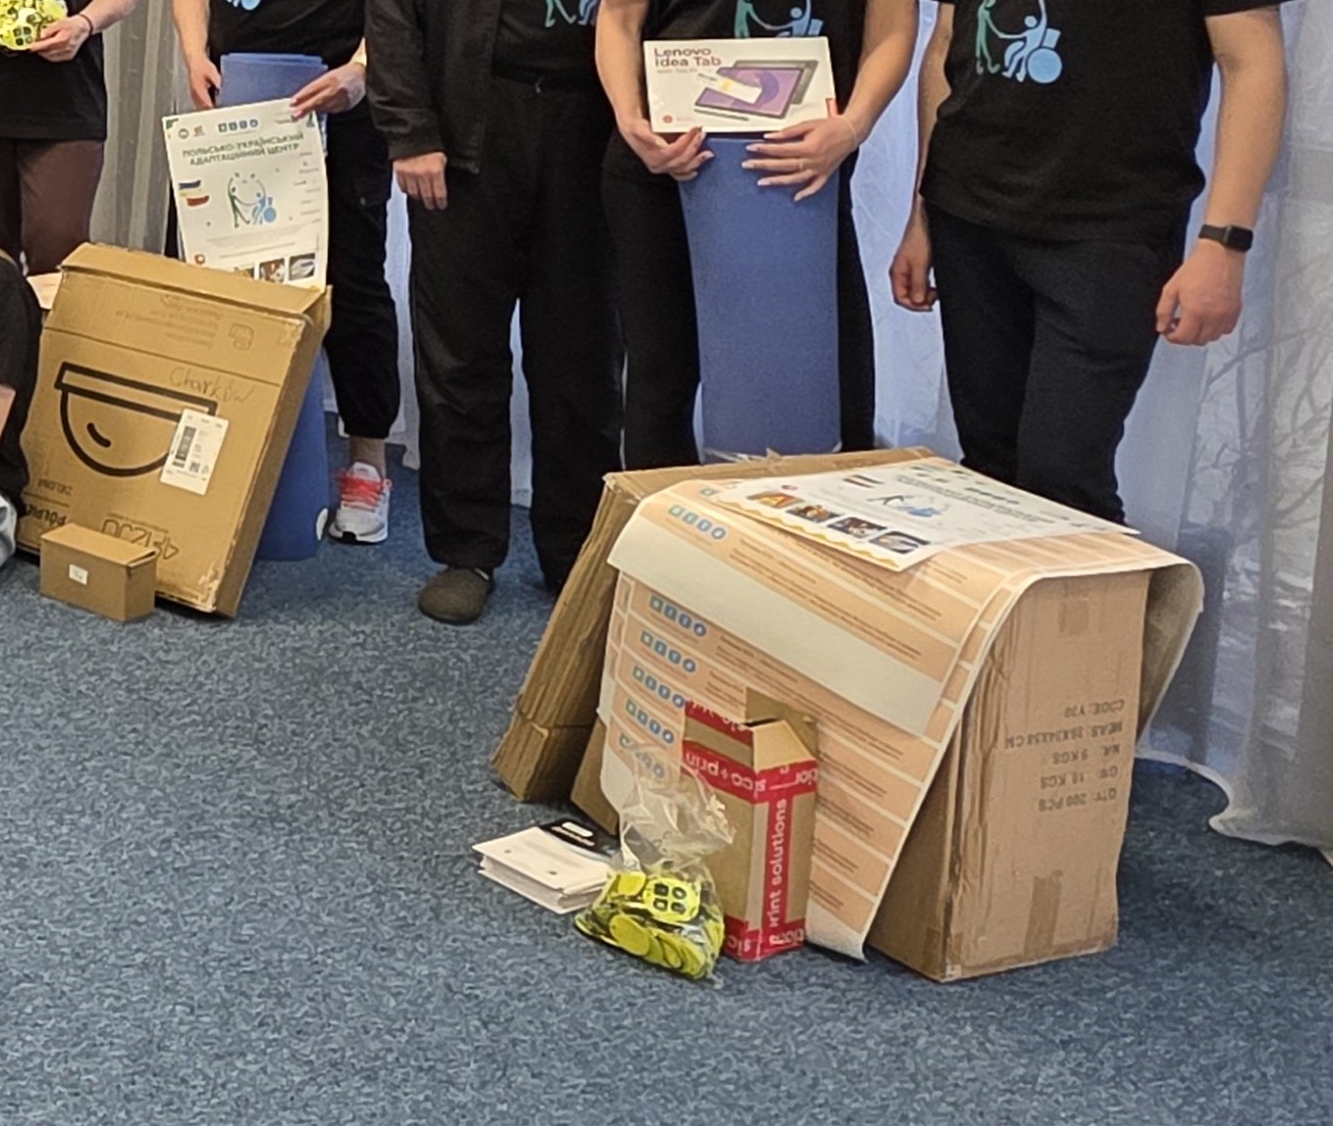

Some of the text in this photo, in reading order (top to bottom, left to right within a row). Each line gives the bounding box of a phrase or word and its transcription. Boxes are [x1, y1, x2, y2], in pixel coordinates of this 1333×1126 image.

[654, 47, 712, 57] Lenovo
[654, 56, 722, 67] Idea Tab
[771, 798, 787, 885] solutions
